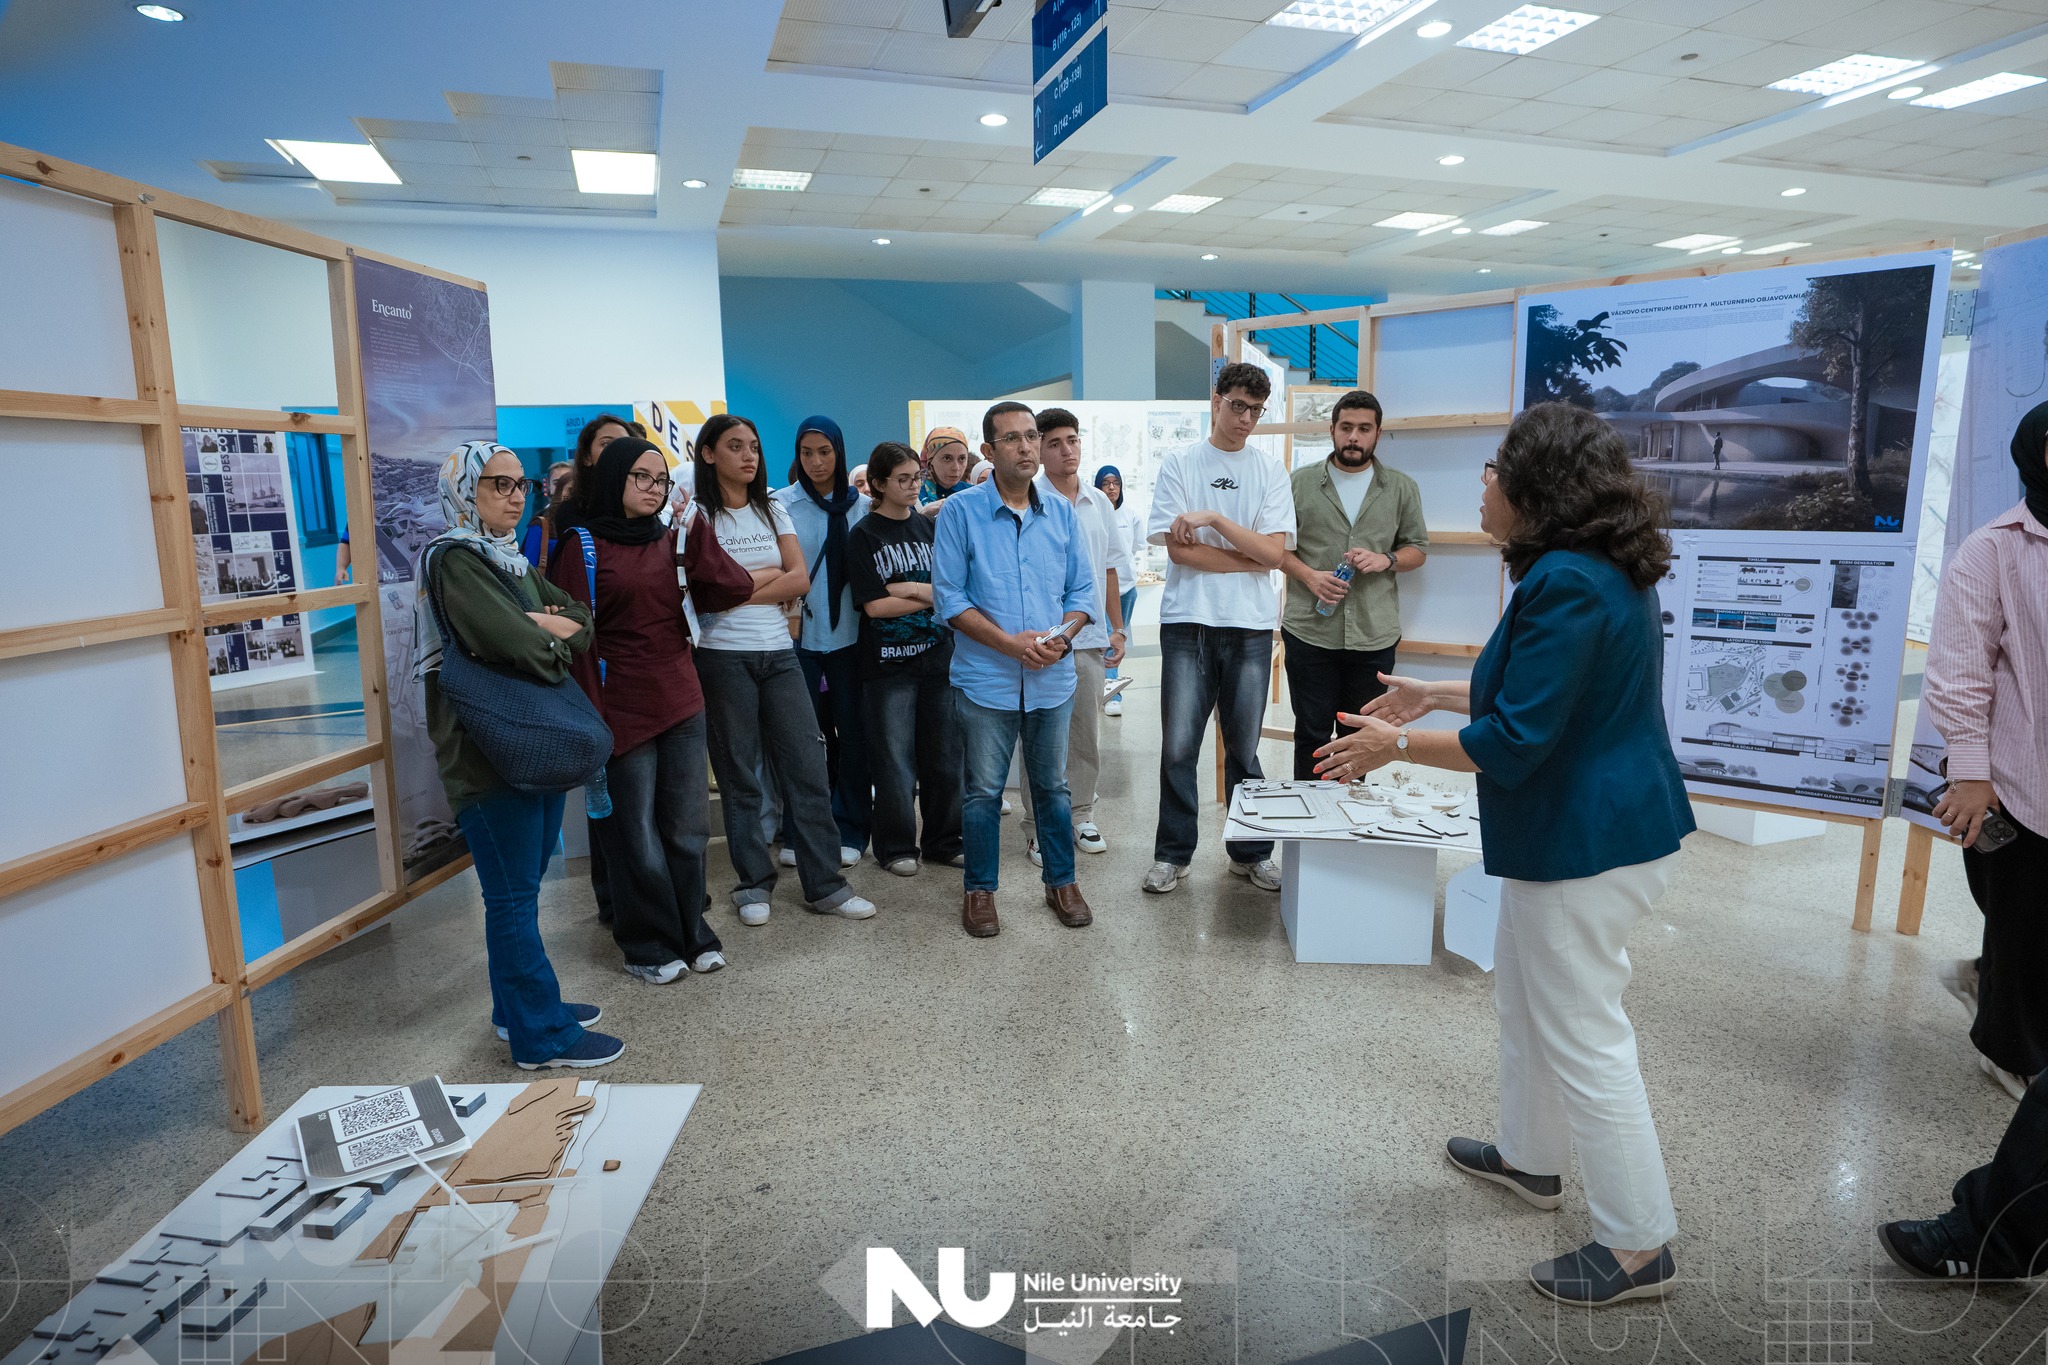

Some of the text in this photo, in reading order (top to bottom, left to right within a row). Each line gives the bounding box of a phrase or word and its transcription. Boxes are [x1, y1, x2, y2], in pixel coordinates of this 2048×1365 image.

[1052, 38, 1057, 51] B
[1053, 87, 1059, 99] C
[1053, 124, 1058, 136] D
[371, 299, 412, 320] Encanto
[1640, 306, 1672, 314] CENTRUM
[1672, 302, 1703, 311] IDENTITY
[218, 436, 236, 513] WE ARE DESCO
[1874, 515, 1900, 527] NU
[717, 533, 775, 546] Calvin Klein
[728, 544, 773, 554] Performance
[1795, 789, 1824, 797] SECONDARY
